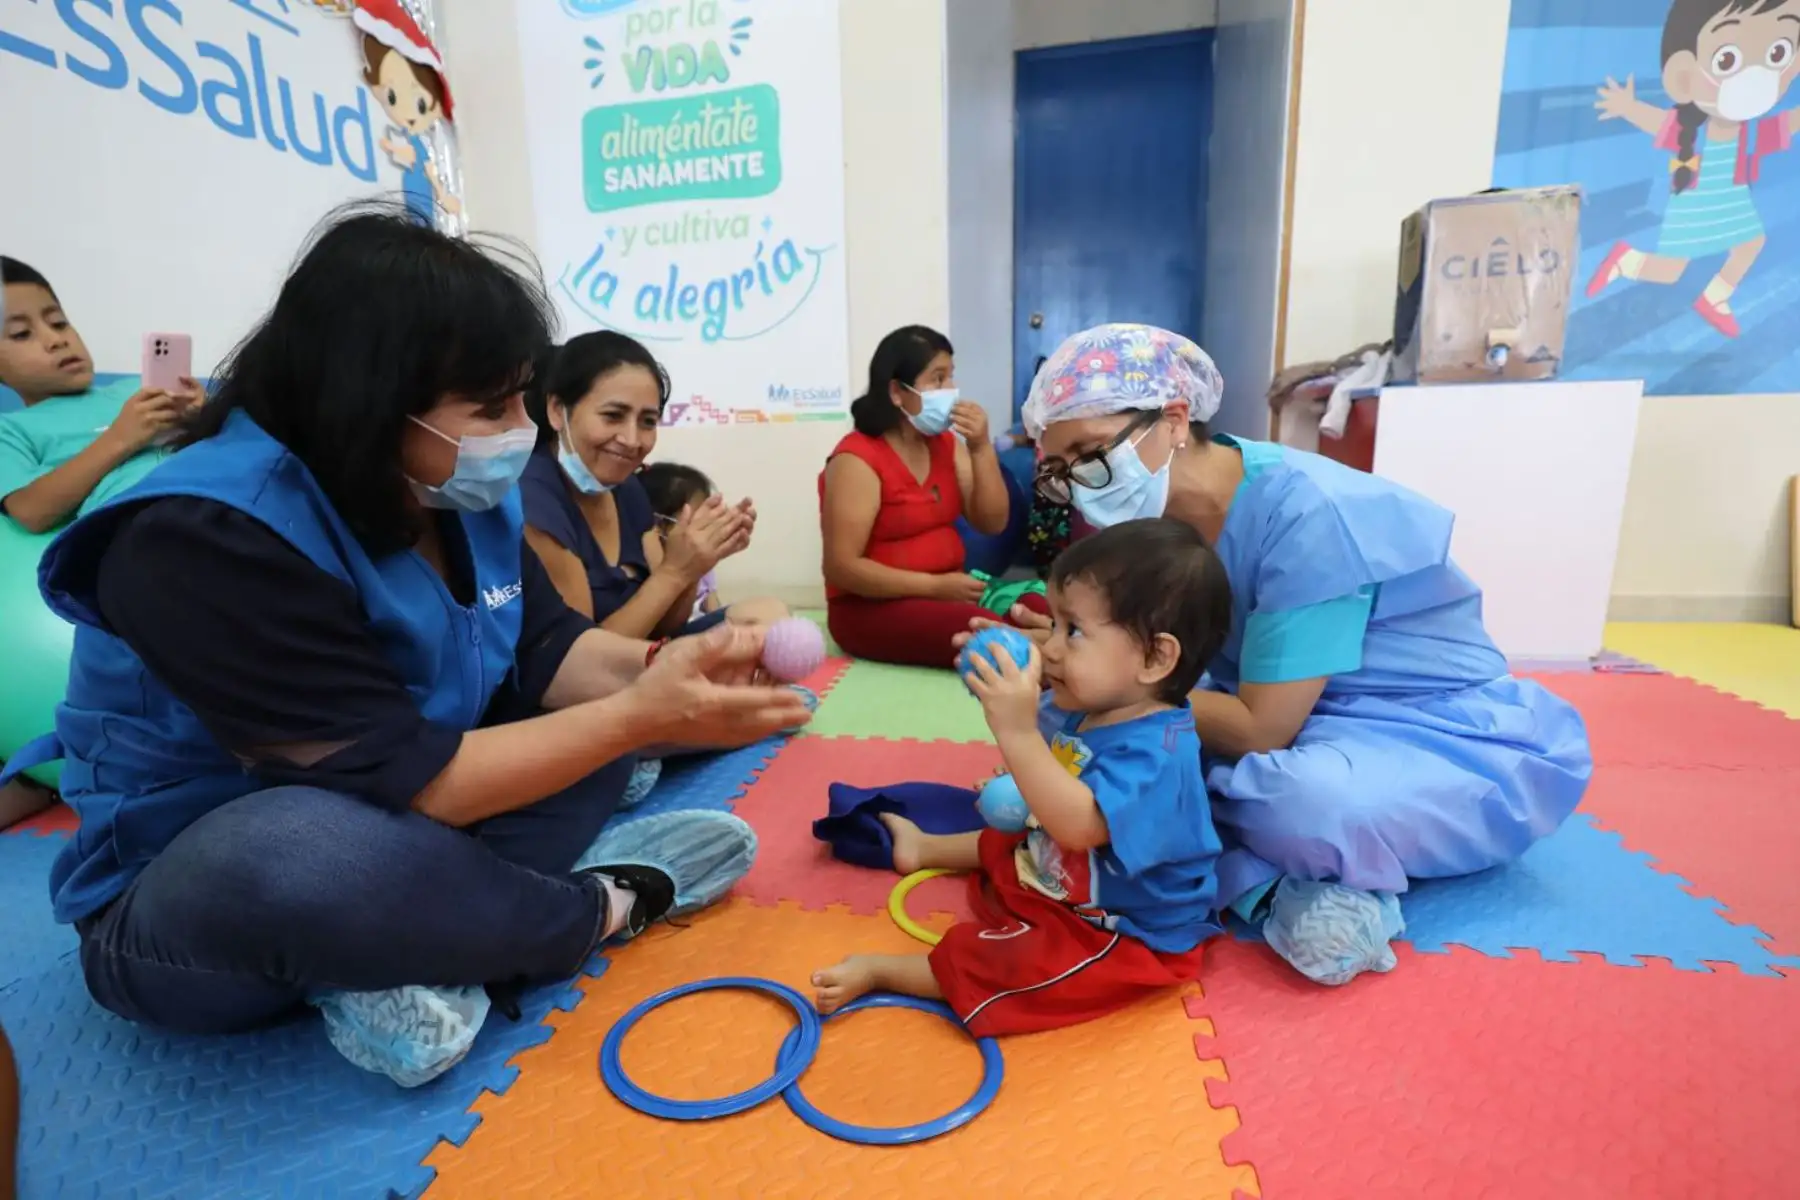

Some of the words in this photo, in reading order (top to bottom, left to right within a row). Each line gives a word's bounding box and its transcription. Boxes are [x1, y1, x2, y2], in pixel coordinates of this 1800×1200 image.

[625, 6, 683, 47] por
[687, 0, 718, 28] la
[0, 0, 378, 182] sSalud
[620, 39, 730, 93] VIDA
[602, 97, 757, 160] aliméntate
[604, 152, 765, 192] SANAMENTE
[620, 225, 637, 258] y
[644, 209, 750, 246] cultiva
[572, 242, 619, 310] la
[634, 238, 804, 343] alegría
